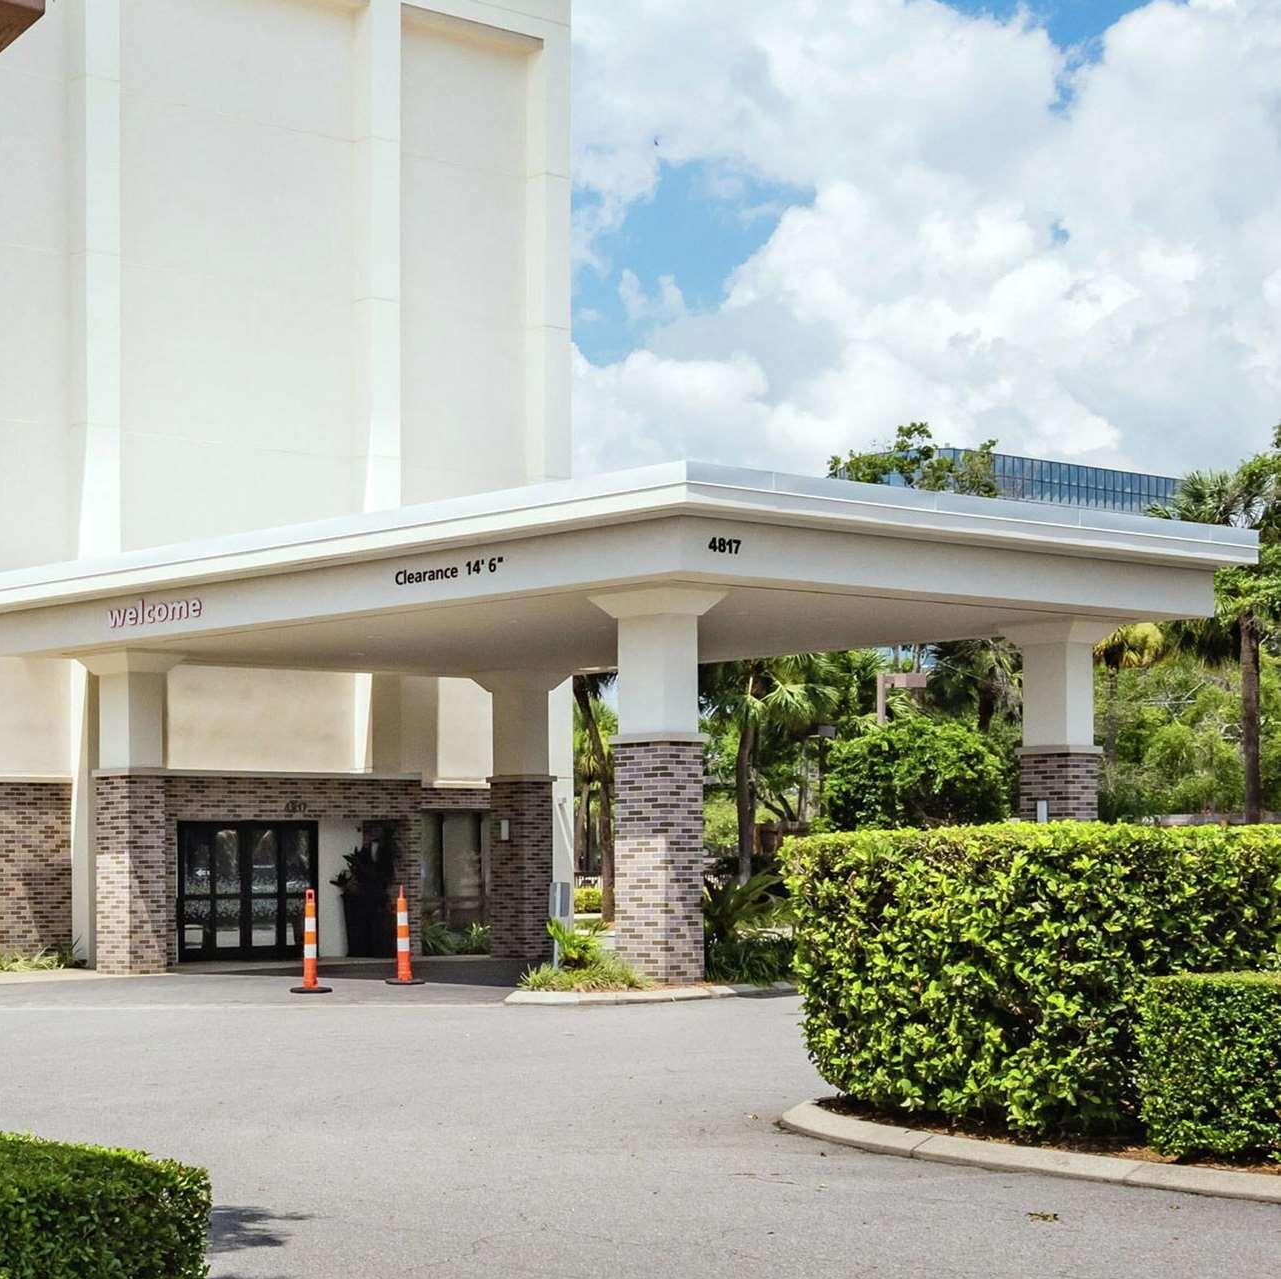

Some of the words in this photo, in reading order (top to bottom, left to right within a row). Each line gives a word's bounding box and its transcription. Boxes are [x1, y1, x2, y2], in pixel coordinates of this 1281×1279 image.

[708, 536, 742, 554] 4817
[395, 567, 459, 585] Clearance
[108, 598, 203, 628] welcome
